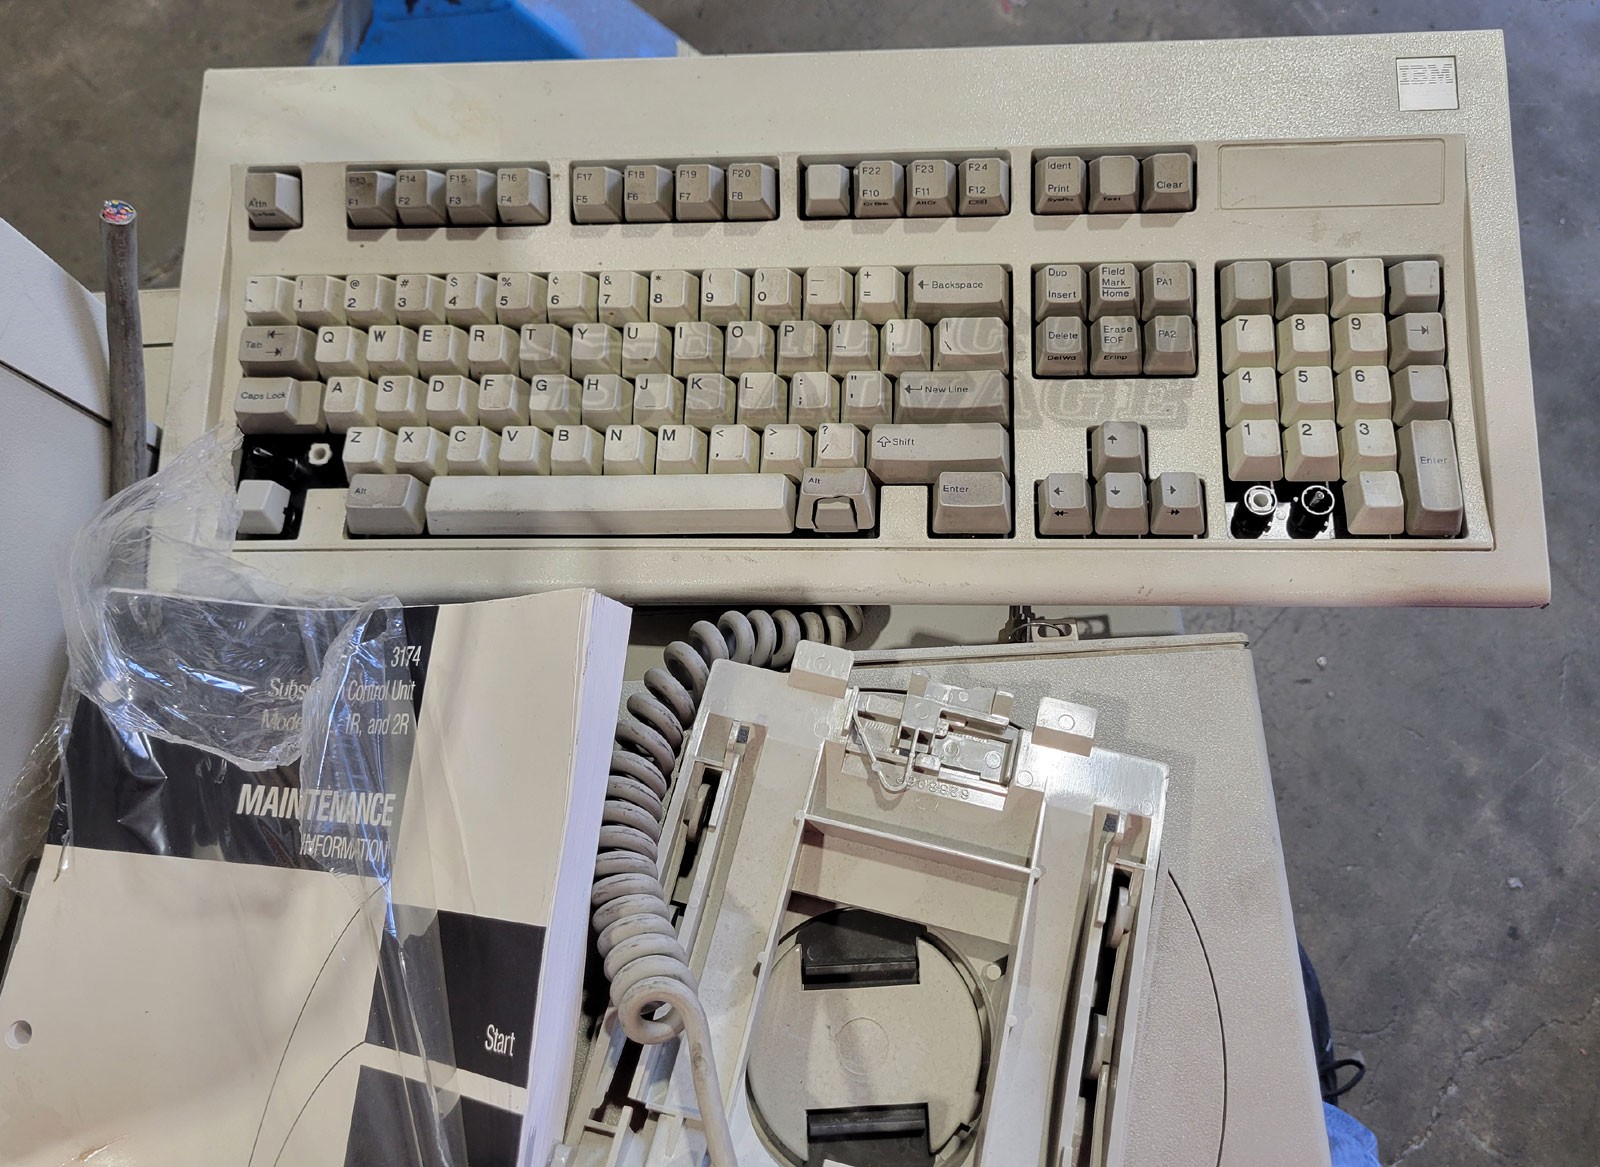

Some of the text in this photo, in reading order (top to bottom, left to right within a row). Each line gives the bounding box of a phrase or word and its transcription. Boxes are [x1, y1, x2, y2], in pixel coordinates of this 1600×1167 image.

[1399, 63, 1453, 85] IBM
[862, 167, 881, 175] F22
[915, 165, 934, 173] F23
[968, 163, 988, 171] F24
[1048, 162, 1071, 170] Ident
[350, 176, 367, 184] F13
[400, 175, 416, 183] F14
[450, 175, 467, 183] F15
[501, 174, 517, 182] F16
[576, 173, 592, 181] F17
[628, 171, 645, 179] F18
[680, 171, 697, 179] F19
[968, 186, 986, 194] F12
[1156, 181, 1183, 189] Clear
[627, 193, 639, 201] F6
[732, 192, 743, 200] F8
[915, 188, 931, 196] F11
[248, 200, 267, 208] Attn
[400, 197, 410, 205] F2
[450, 197, 461, 205] F3
[501, 196, 512, 204] F4
[576, 195, 588, 203] F5
[1102, 267, 1125, 275] Field
[350, 279, 360, 289] @
[400, 279, 409, 288] #
[451, 277, 458, 287] $
[502, 277, 512, 287] %
[604, 276, 612, 285] &
[932, 281, 984, 290] Backspace
[1102, 278, 1126, 286] Mark
[603, 294, 611, 304] 7
[653, 294, 663, 303] 8
[706, 292, 714, 302] 9
[1102, 290, 1130, 298] Home
[347, 298, 356, 308] 2
[398, 297, 407, 307] 3
[448, 297, 457, 306] 4
[500, 296, 508, 306] 5
[551, 295, 560, 305] 6
[1103, 325, 1133, 333] Erase
[1239, 319, 1249, 331] 7
[1295, 319, 1306, 331] 8
[1351, 318, 1362, 331] 9
[422, 330, 433, 342] E
[474, 330, 485, 342] R
[526, 329, 536, 340] T
[578, 328, 588, 340] Y
[627, 328, 638, 339] U
[784, 325, 795, 337] P
[1158, 330, 1177, 338] PA2
[323, 331, 335, 344] Q
[374, 331, 386, 342] W
[1104, 336, 1124, 344] EOF
[246, 341, 263, 349] Tab
[1242, 371, 1252, 383] 4
[1298, 370, 1309, 383] 5
[1355, 370, 1365, 382] 6
[332, 382, 343, 393] A
[382, 381, 394, 393] S
[433, 380, 444, 392] D
[484, 379, 495, 391] F
[536, 379, 548, 391] G
[587, 379, 599, 390] H
[640, 378, 649, 390] J
[691, 378, 703, 389] K
[744, 377, 754, 389] L
[925, 385, 968, 393] New Line
[241, 391, 287, 400] Caps Lock
[822, 426, 829, 435] ?
[1244, 423, 1251, 436] 1
[1302, 423, 1313, 436] 2
[1359, 422, 1370, 436] 3
[350, 431, 362, 443] Z
[402, 431, 414, 443] X
[454, 430, 467, 442] C
[507, 430, 519, 442] V
[558, 430, 569, 441] B
[610, 430, 622, 441] N
[662, 430, 676, 441] M
[892, 438, 915, 446] Shift
[1420, 456, 1448, 465] Enter
[808, 477, 821, 485] Alt
[354, 487, 367, 495] Alt
[944, 485, 969, 493] Enter
[390, 646, 421, 667] 3174
[347, 679, 416, 701] Control Unit
[344, 713, 363, 737] 1R,
[368, 714, 389, 735] and
[391, 713, 410, 735] 2R
[236, 784, 397, 827] MAINTENANCE
[299, 832, 390, 863] INFORMATION
[484, 1024, 516, 1057] Start
